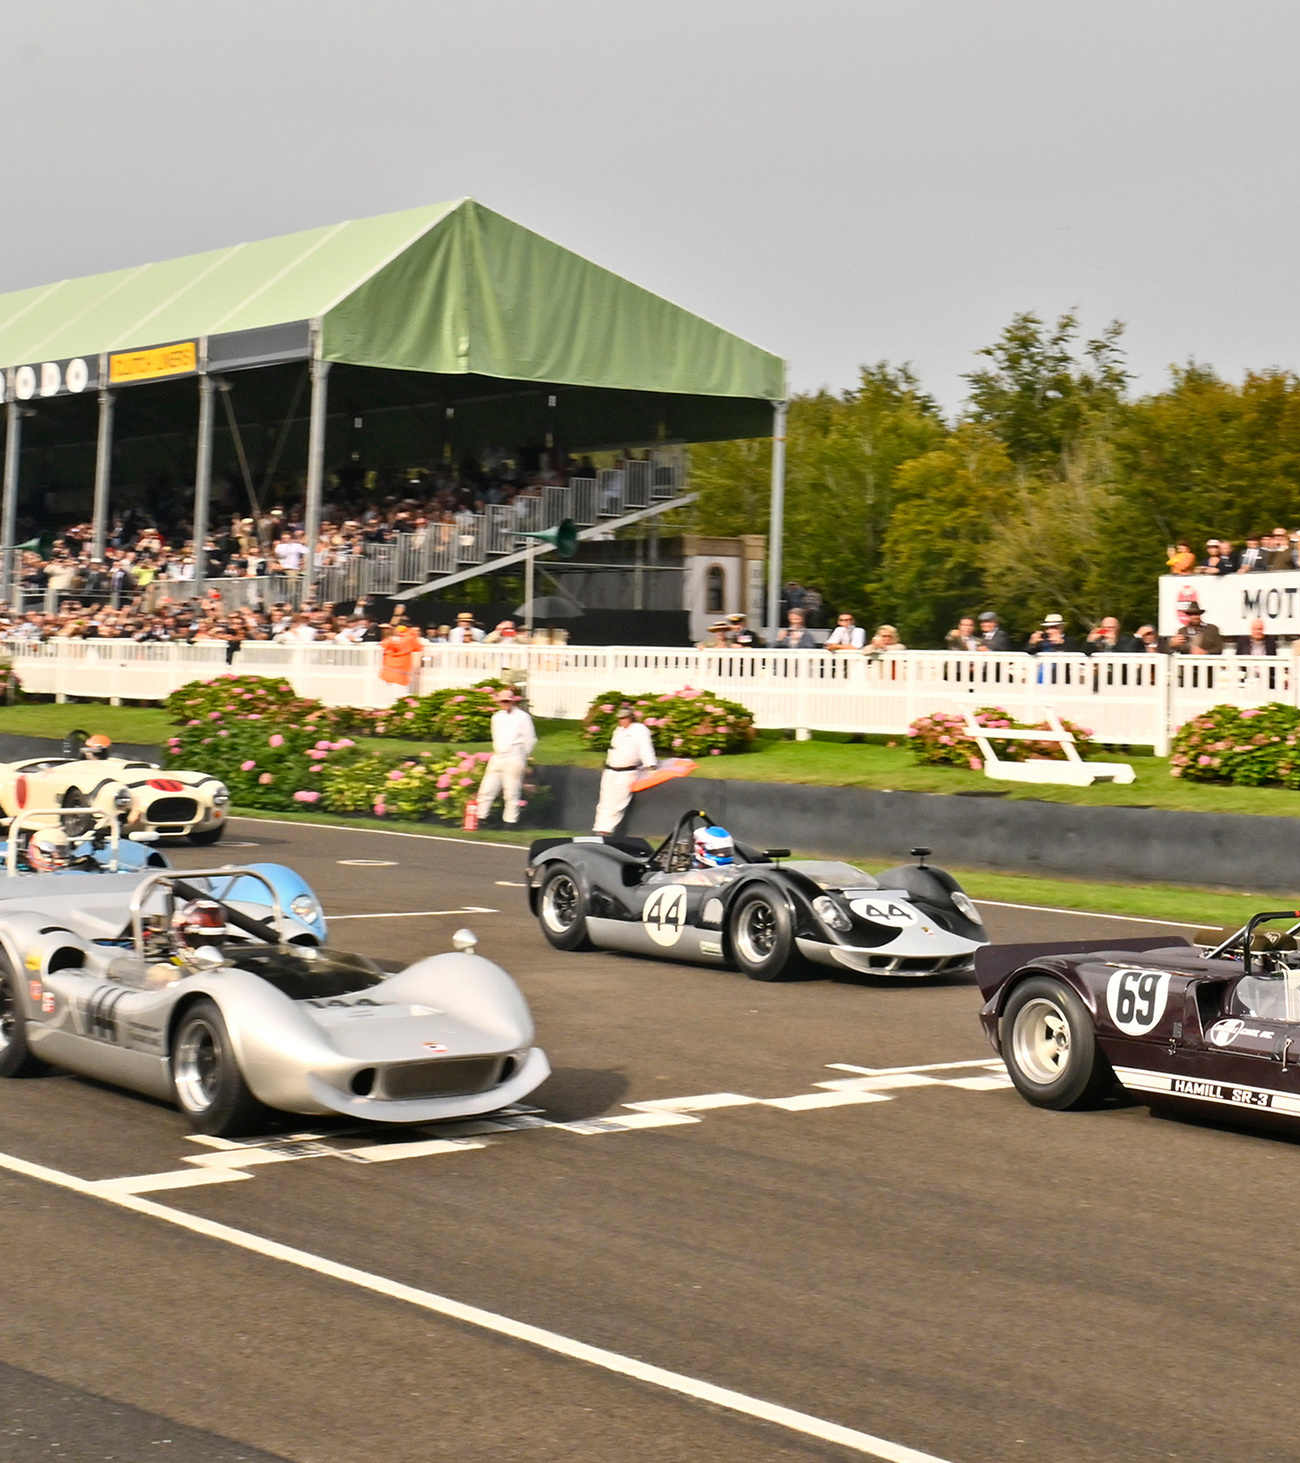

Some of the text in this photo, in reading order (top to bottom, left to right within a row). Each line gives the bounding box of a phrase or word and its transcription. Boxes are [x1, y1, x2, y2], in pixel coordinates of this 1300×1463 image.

[0, 358, 89, 403] ODO
[647, 892, 682, 932] 44
[866, 904, 913, 920] 44
[1116, 971, 1163, 1026] 69
[1174, 1080, 1269, 1107] HAMILL SR-3
